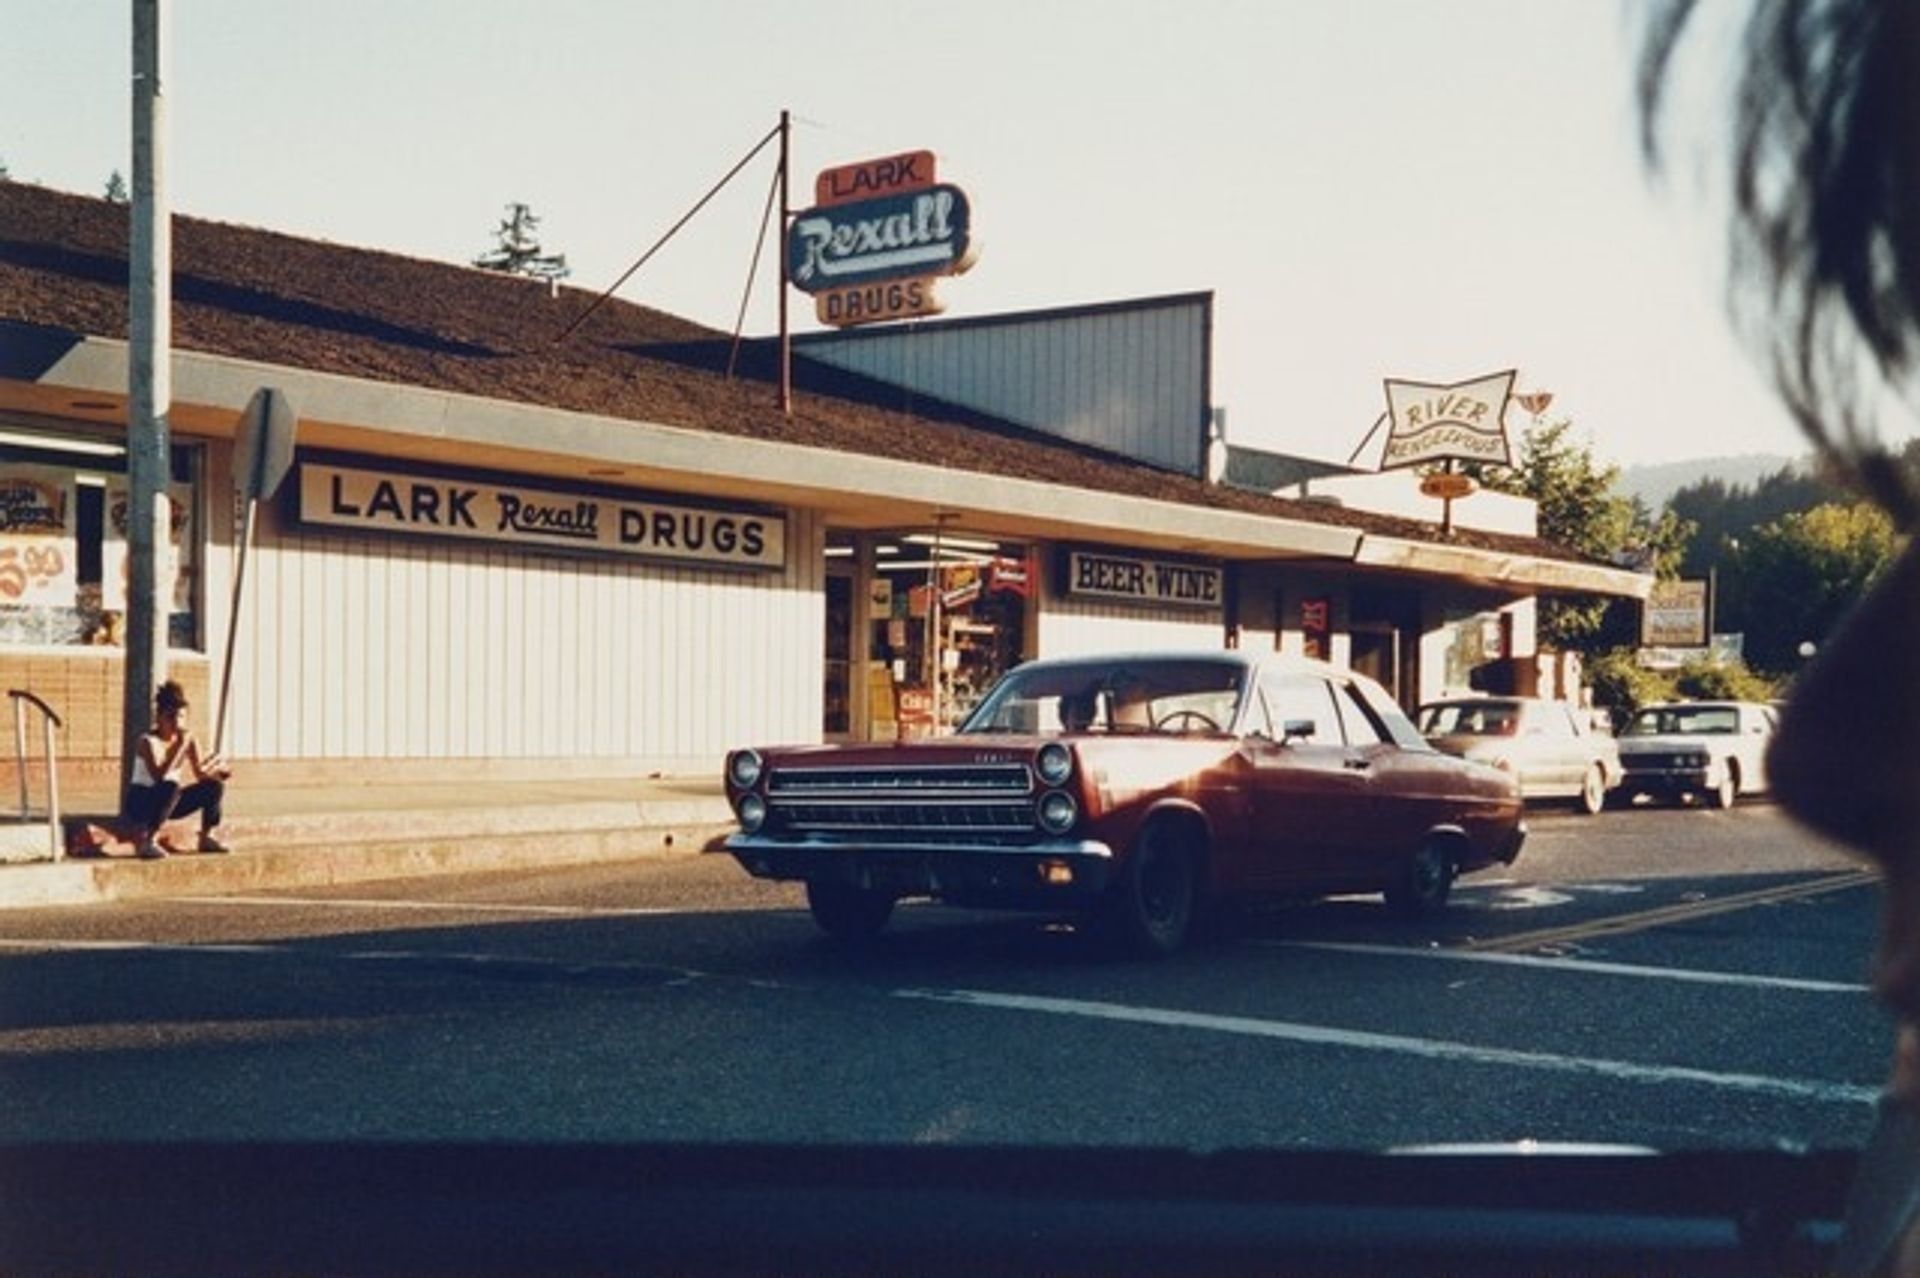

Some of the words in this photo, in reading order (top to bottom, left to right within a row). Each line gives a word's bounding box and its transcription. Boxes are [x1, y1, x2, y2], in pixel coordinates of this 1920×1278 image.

[830, 157, 918, 197] LARK
[797, 190, 954, 281] Rexall
[826, 281, 923, 319] DRUGS
[1405, 393, 1489, 428] RIVER
[331, 473, 479, 529] LARK
[496, 493, 599, 541] Rexall
[618, 507, 764, 556] DRUGS
